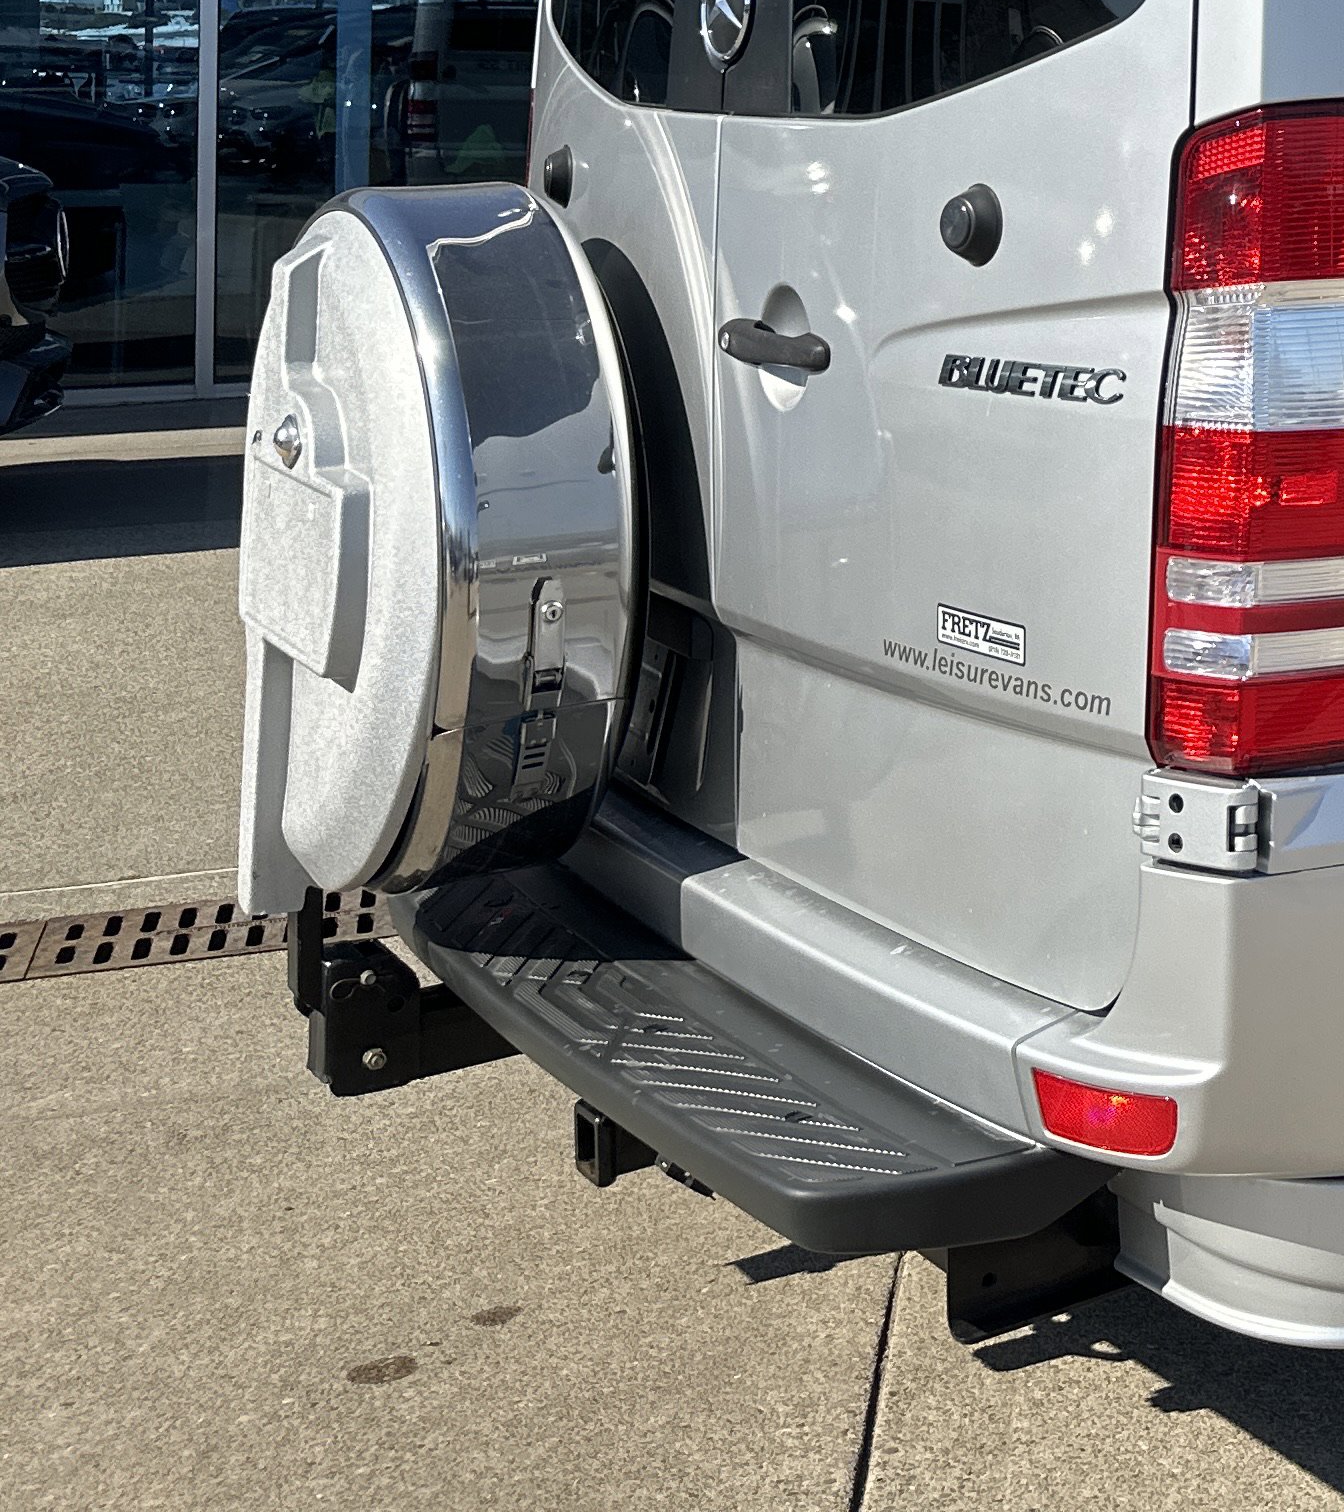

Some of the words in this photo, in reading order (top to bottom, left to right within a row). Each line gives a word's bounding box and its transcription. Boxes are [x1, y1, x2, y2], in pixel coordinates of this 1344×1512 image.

[938, 353, 1127, 406] BLUETEC
[941, 610, 991, 643] FRETZ
[883, 638, 1112, 717] www.leisurevans.com
